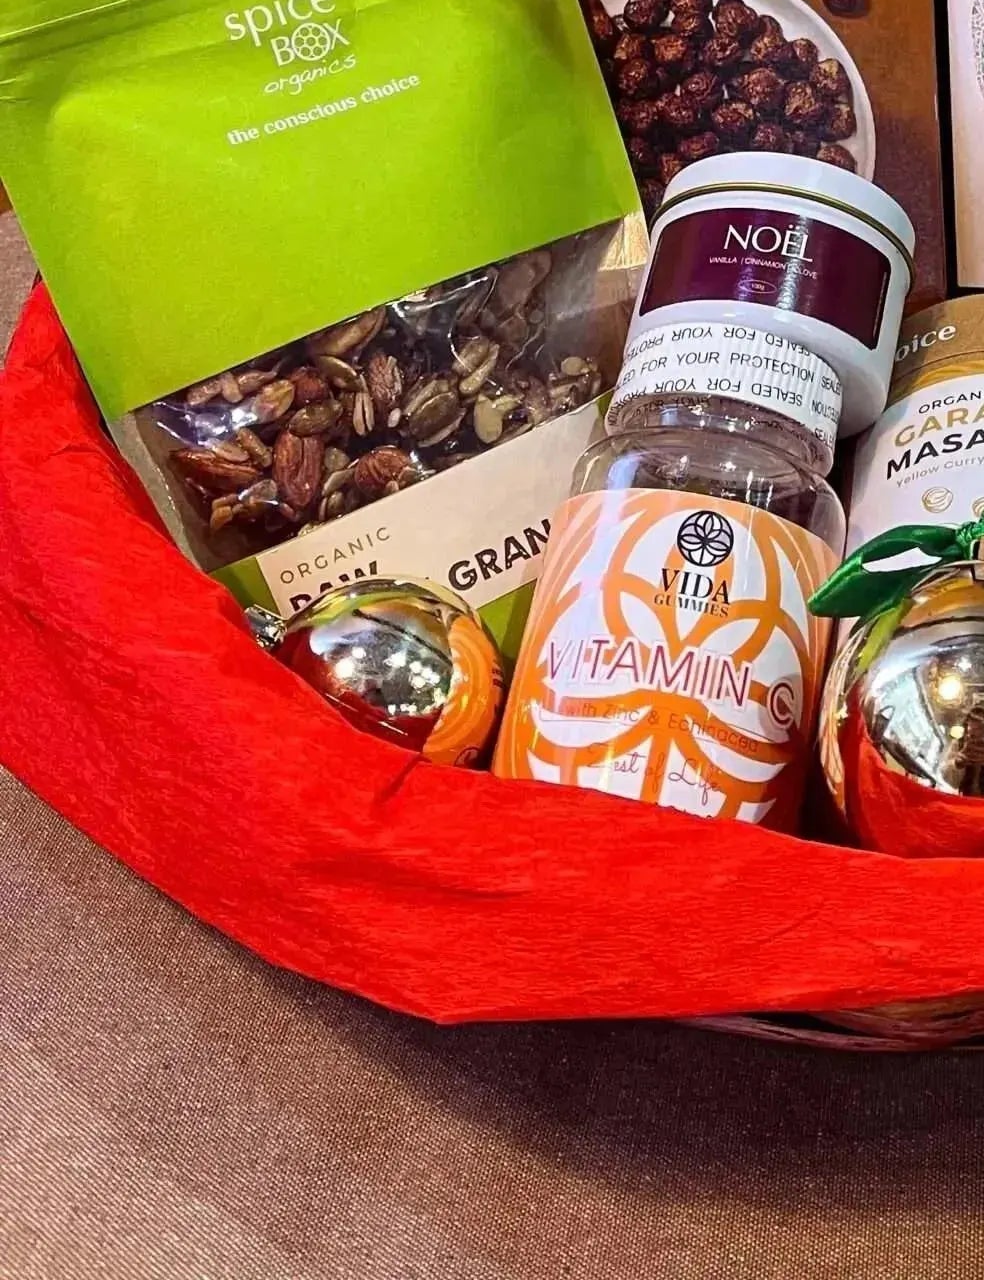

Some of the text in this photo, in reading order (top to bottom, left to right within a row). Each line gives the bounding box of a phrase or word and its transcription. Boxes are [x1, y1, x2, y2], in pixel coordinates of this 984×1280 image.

[270, 19, 350, 66] BOX
[264, 54, 356, 95] organics
[227, 74, 421, 145] the conscious choice
[723, 224, 813, 263] NOËL
[709, 256, 738, 264] VANILLA
[744, 257, 786, 270] CINNAMON
[672, 326, 714, 341] YOUR
[724, 327, 756, 341] FOR
[640, 357, 668, 374] FOR
[676, 351, 720, 365] YOUR
[729, 352, 815, 383] PROTECTION
[655, 377, 697, 394] YOUR
[707, 377, 742, 393] FOR
[751, 382, 804, 407] SEALED
[895, 465, 940, 488] Yellow
[280, 526, 391, 584] ORGANIC
[661, 568, 730, 605] VIDA
[653, 593, 729, 618] GUMMIES
[549, 638, 751, 707] VITAMIN
[768, 681, 795, 727] C
[602, 703, 640, 722] Zinc
[647, 711, 660, 726] &
